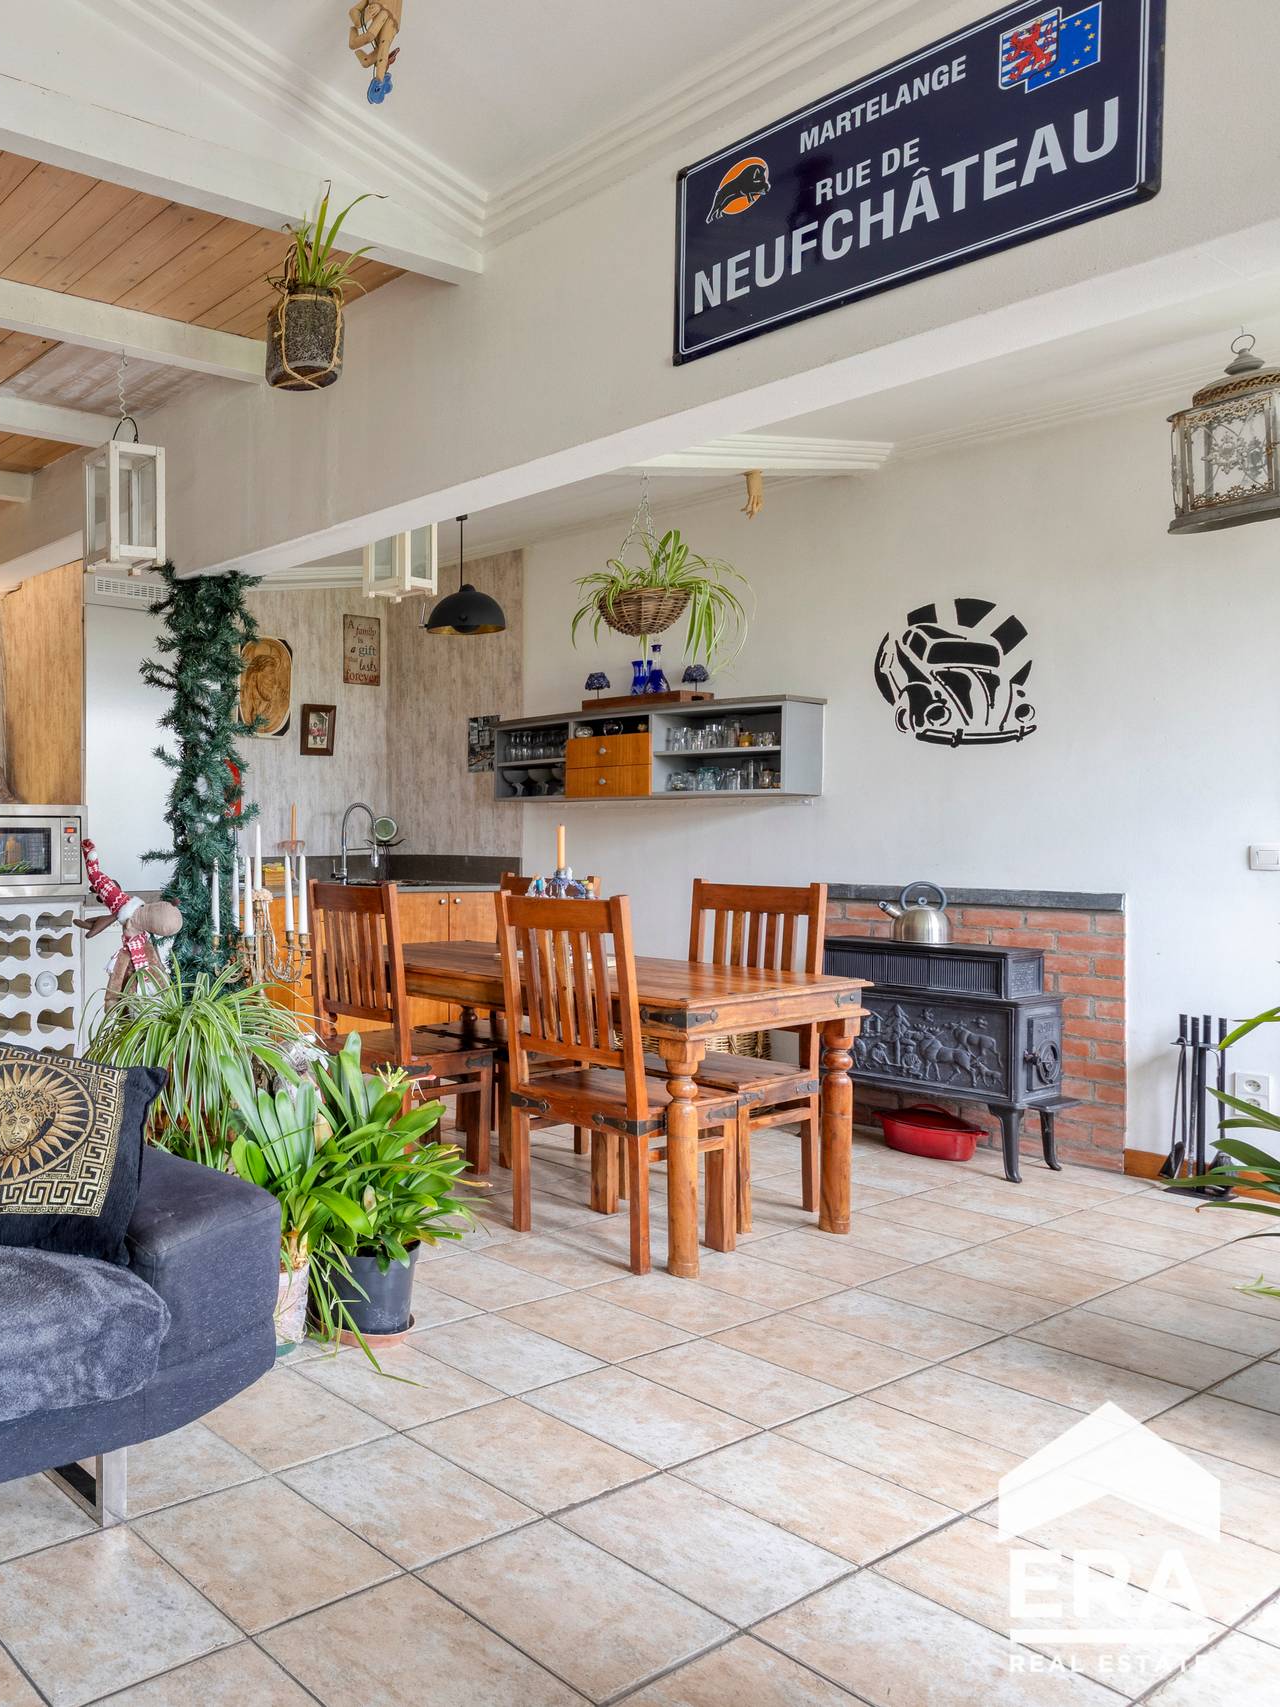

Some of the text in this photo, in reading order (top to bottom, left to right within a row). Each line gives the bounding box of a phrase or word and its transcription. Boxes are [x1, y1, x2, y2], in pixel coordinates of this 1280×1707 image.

[799, 55, 967, 154] MARTELANGE
[693, 96, 1119, 315] NEUFCHÂTEAU
[815, 137, 920, 206] RUE DE
[358, 645, 376, 656] gift
[360, 658, 376, 672] lasts
